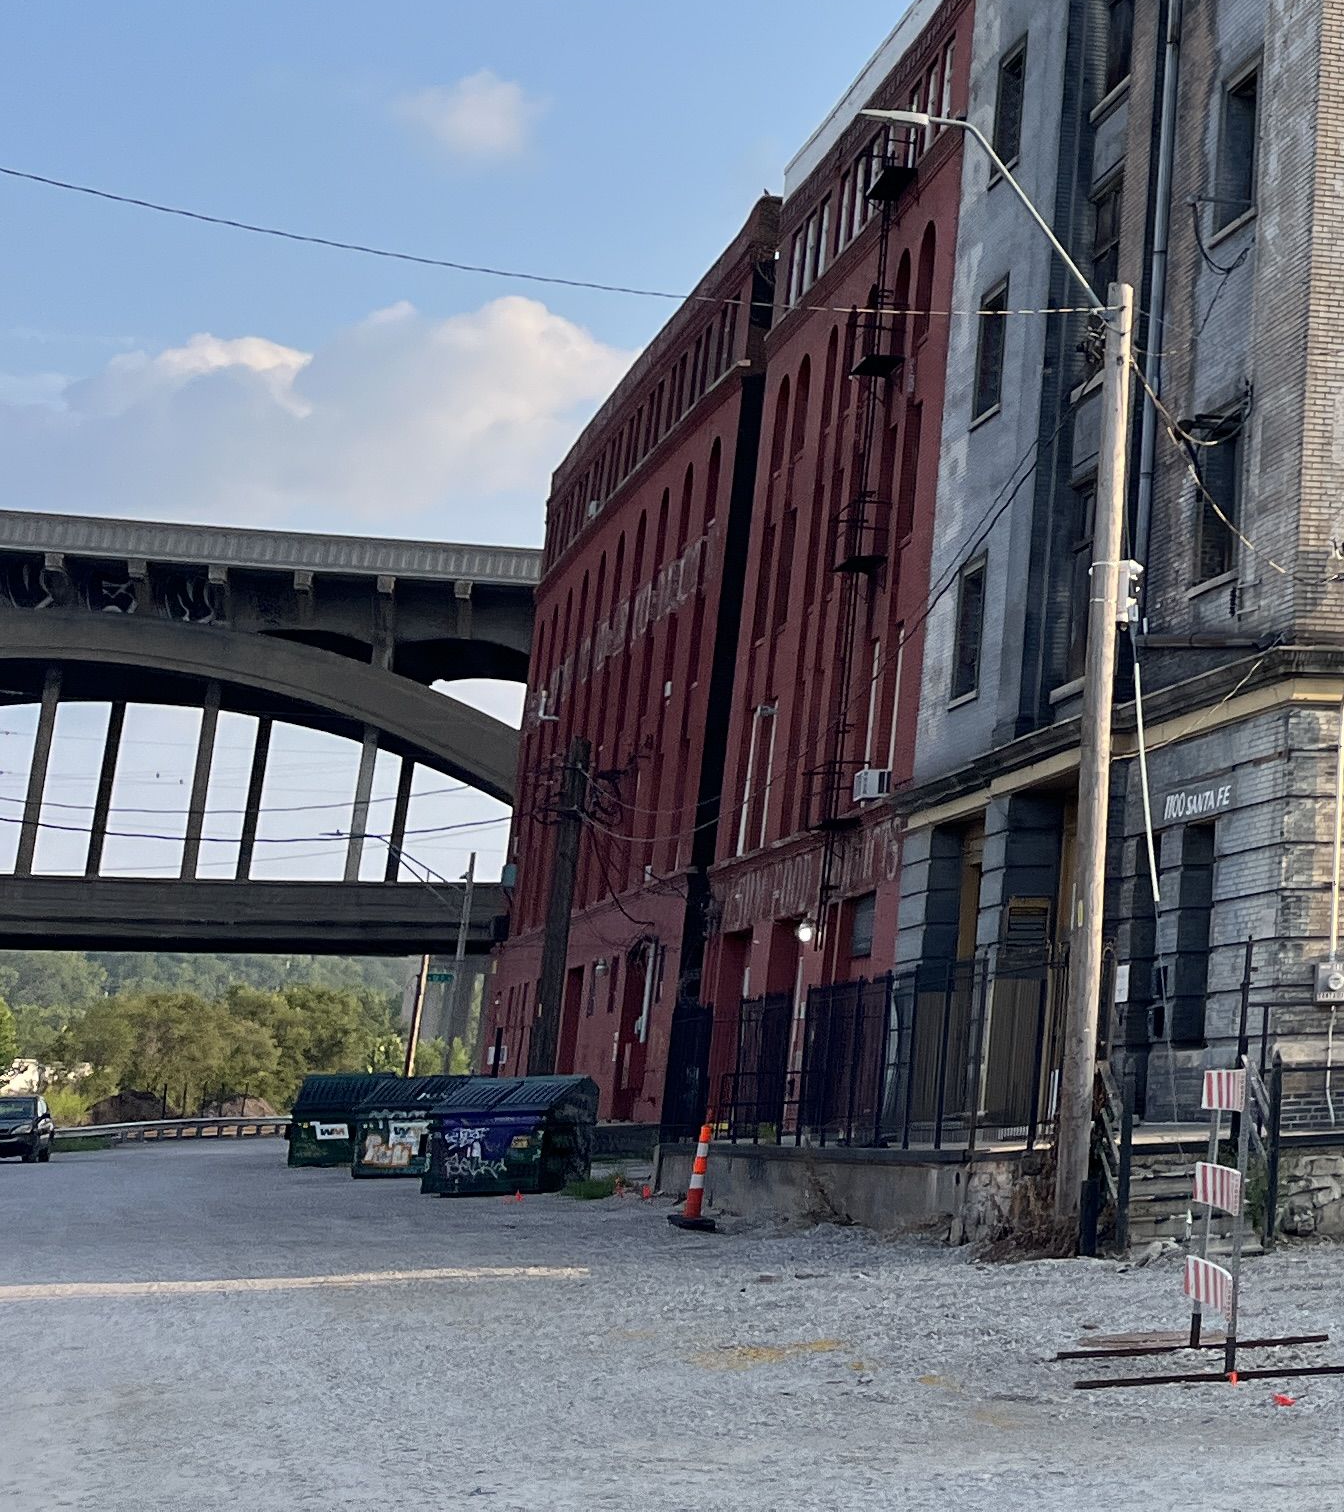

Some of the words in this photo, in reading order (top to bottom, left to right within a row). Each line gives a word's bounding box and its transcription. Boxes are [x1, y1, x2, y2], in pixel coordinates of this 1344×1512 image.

[1164, 791, 1186, 820] 1100
[1186, 790, 1215, 815] SANTA
[1216, 785, 1232, 807] FE
